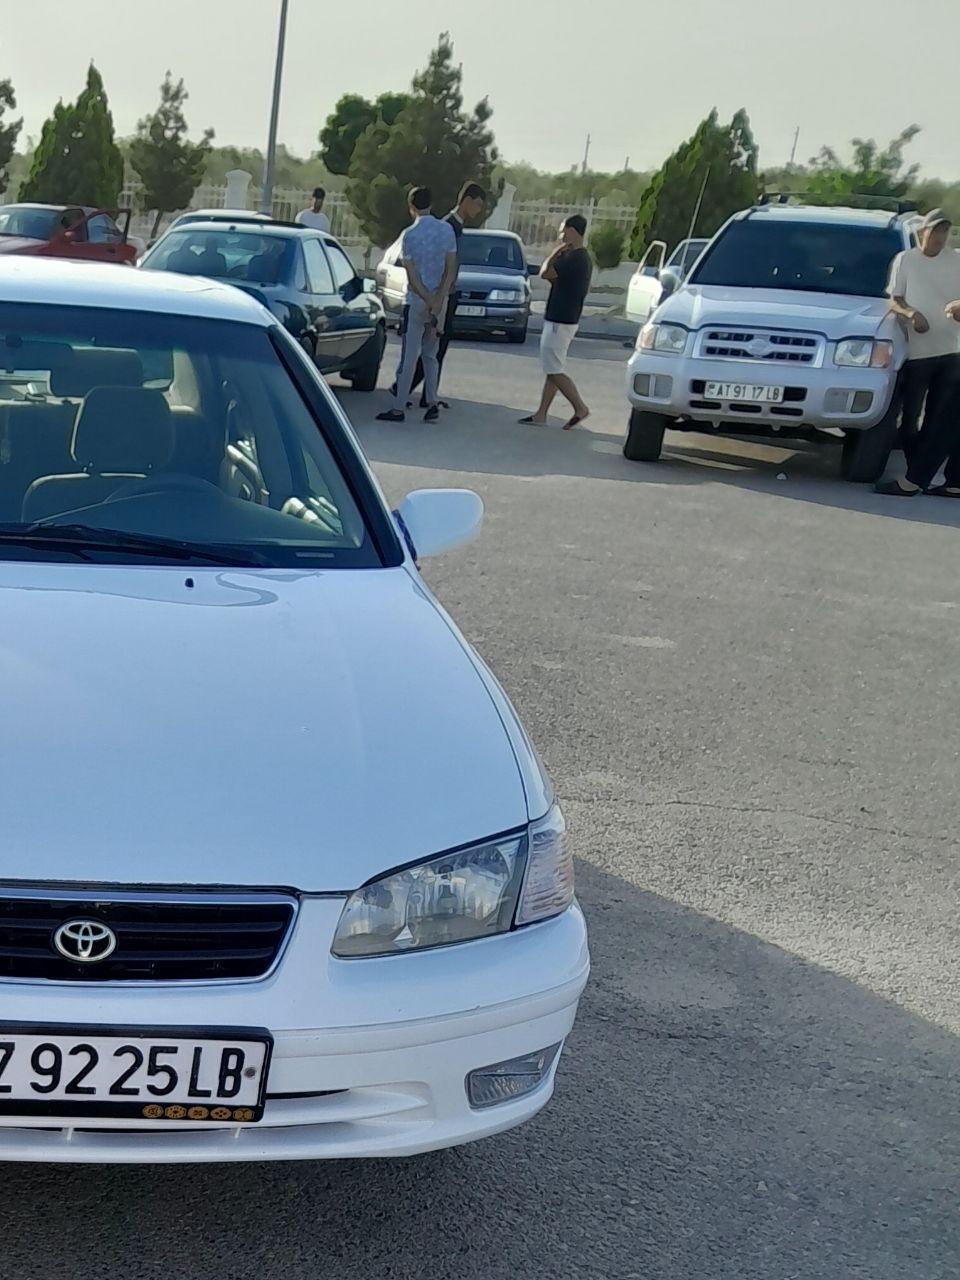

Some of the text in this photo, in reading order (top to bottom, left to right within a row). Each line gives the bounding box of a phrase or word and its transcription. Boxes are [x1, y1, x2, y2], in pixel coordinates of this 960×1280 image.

[29, 1042, 100, 1095] 92
[108, 1044, 179, 1097] 25
[187, 1046, 246, 1099] LB
